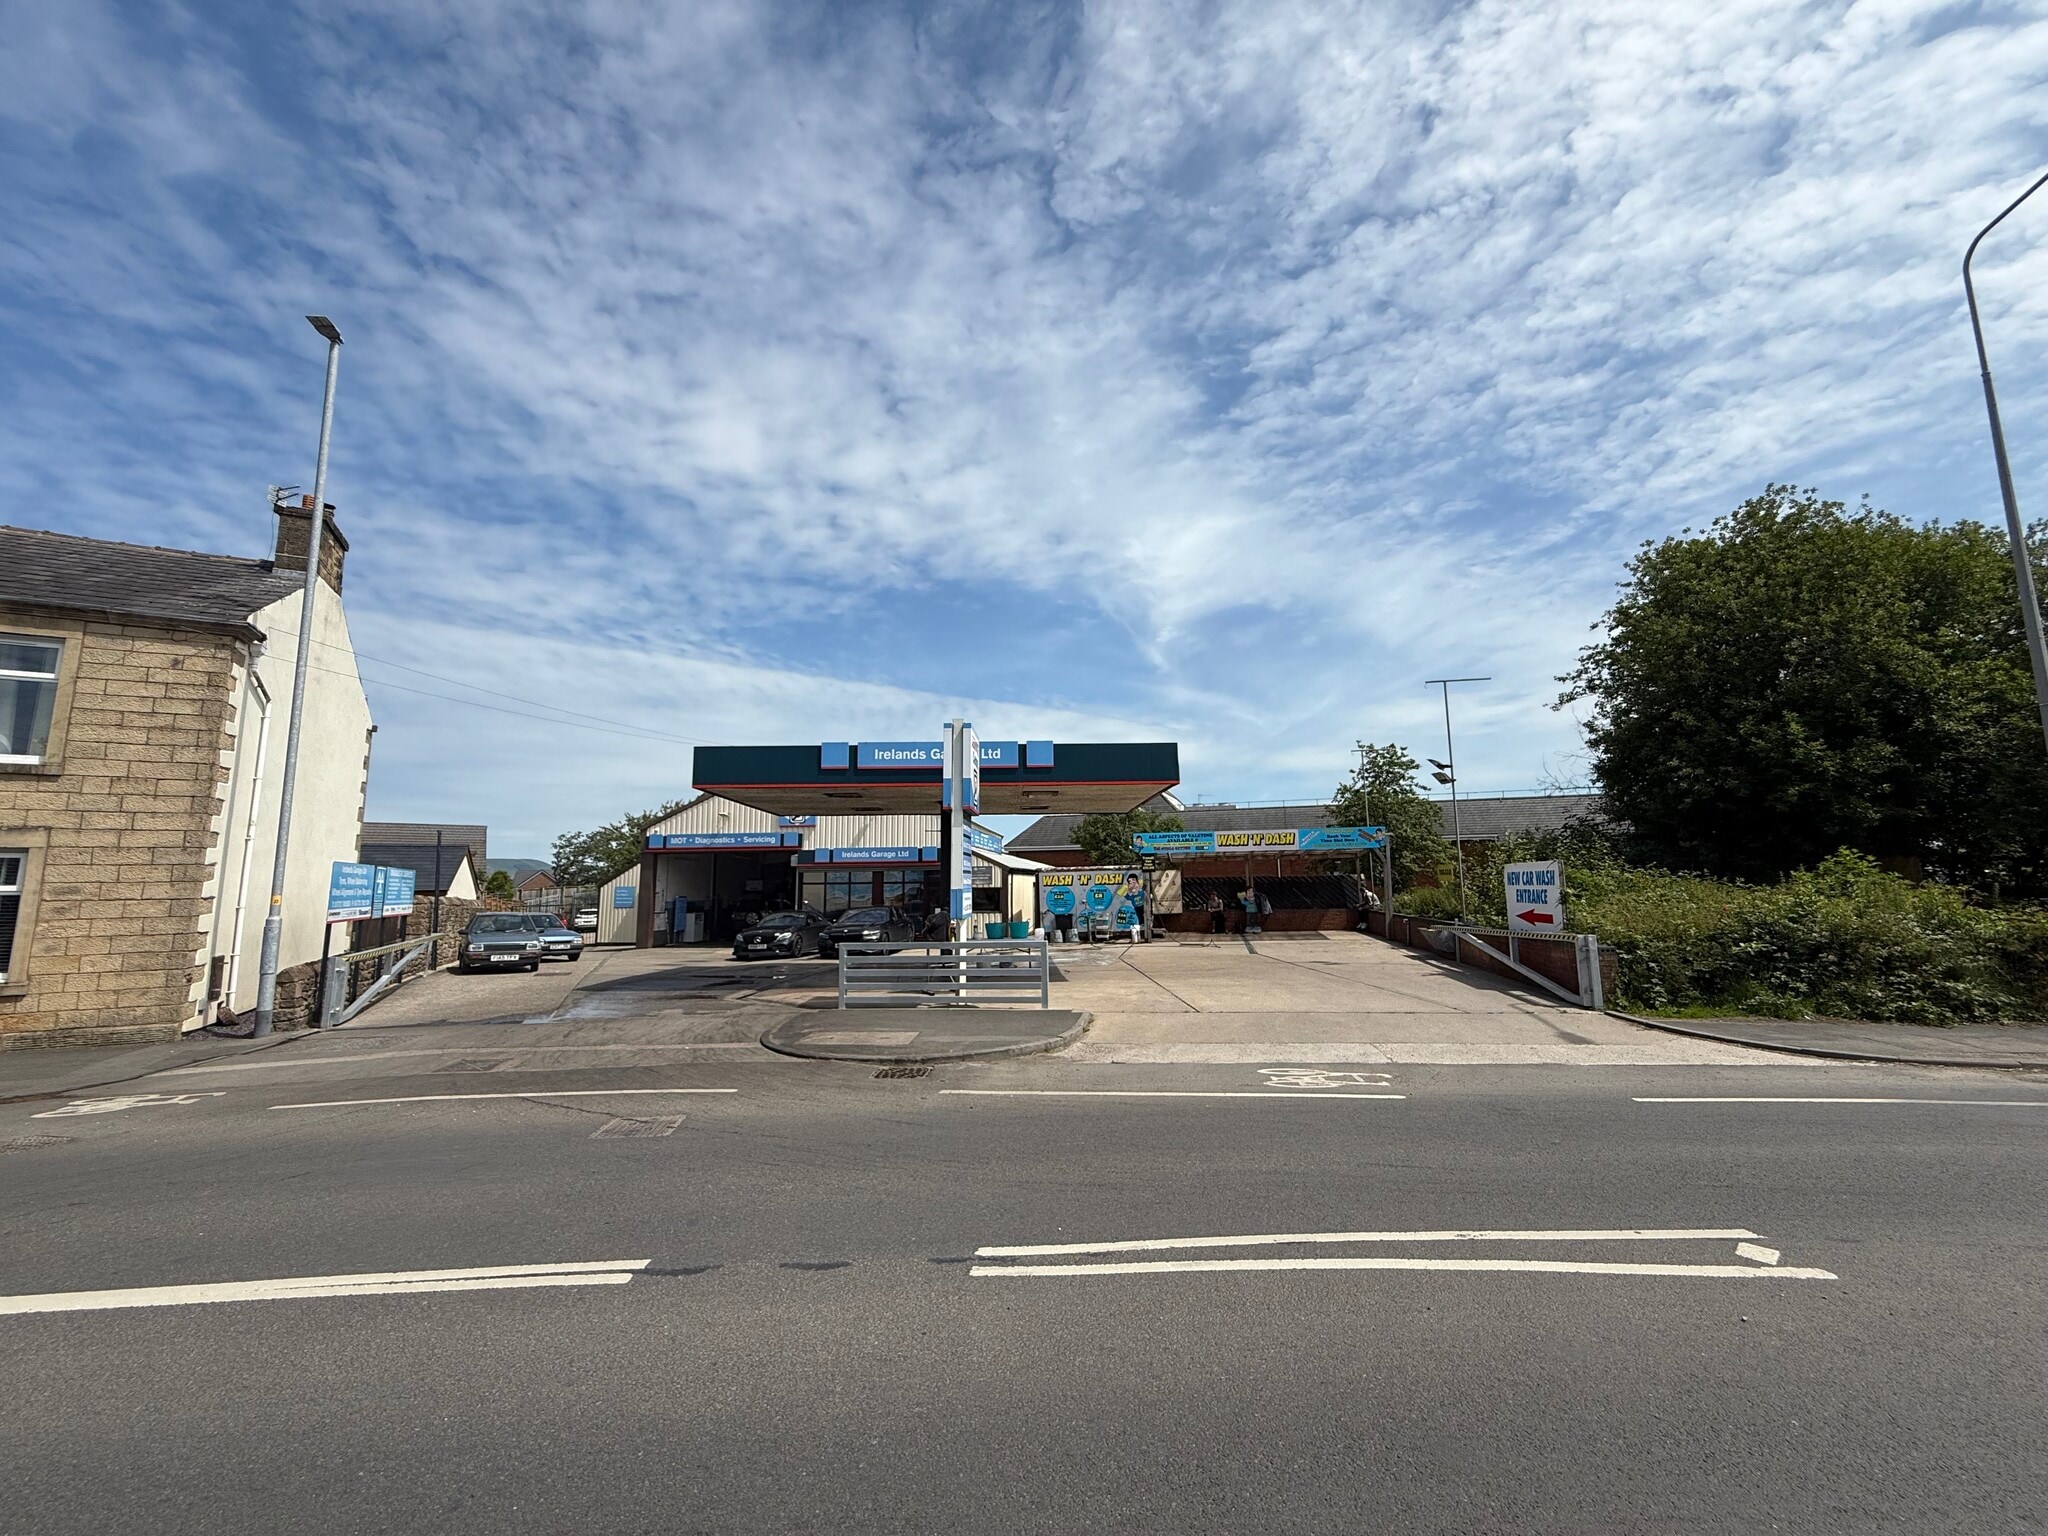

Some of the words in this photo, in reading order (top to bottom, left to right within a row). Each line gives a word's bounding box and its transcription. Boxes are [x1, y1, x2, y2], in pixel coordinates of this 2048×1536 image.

[874, 748, 926, 760] Irelands
[981, 748, 1001, 759] Ltd
[695, 836, 735, 845] Diagnostics
[743, 835, 776, 844] Servicing
[1217, 833, 1249, 847] WASH
[1264, 832, 1295, 846] DASH
[871, 851, 896, 859] Garage
[1042, 874, 1073, 886] WASH
[1077, 874, 1091, 885] 'N'
[1094, 873, 1124, 885] DASH
[1507, 871, 1520, 886] NEW
[1522, 870, 1534, 886] CAR
[1535, 869, 1555, 886] WASH
[1516, 888, 1548, 904] ENTRANCE
